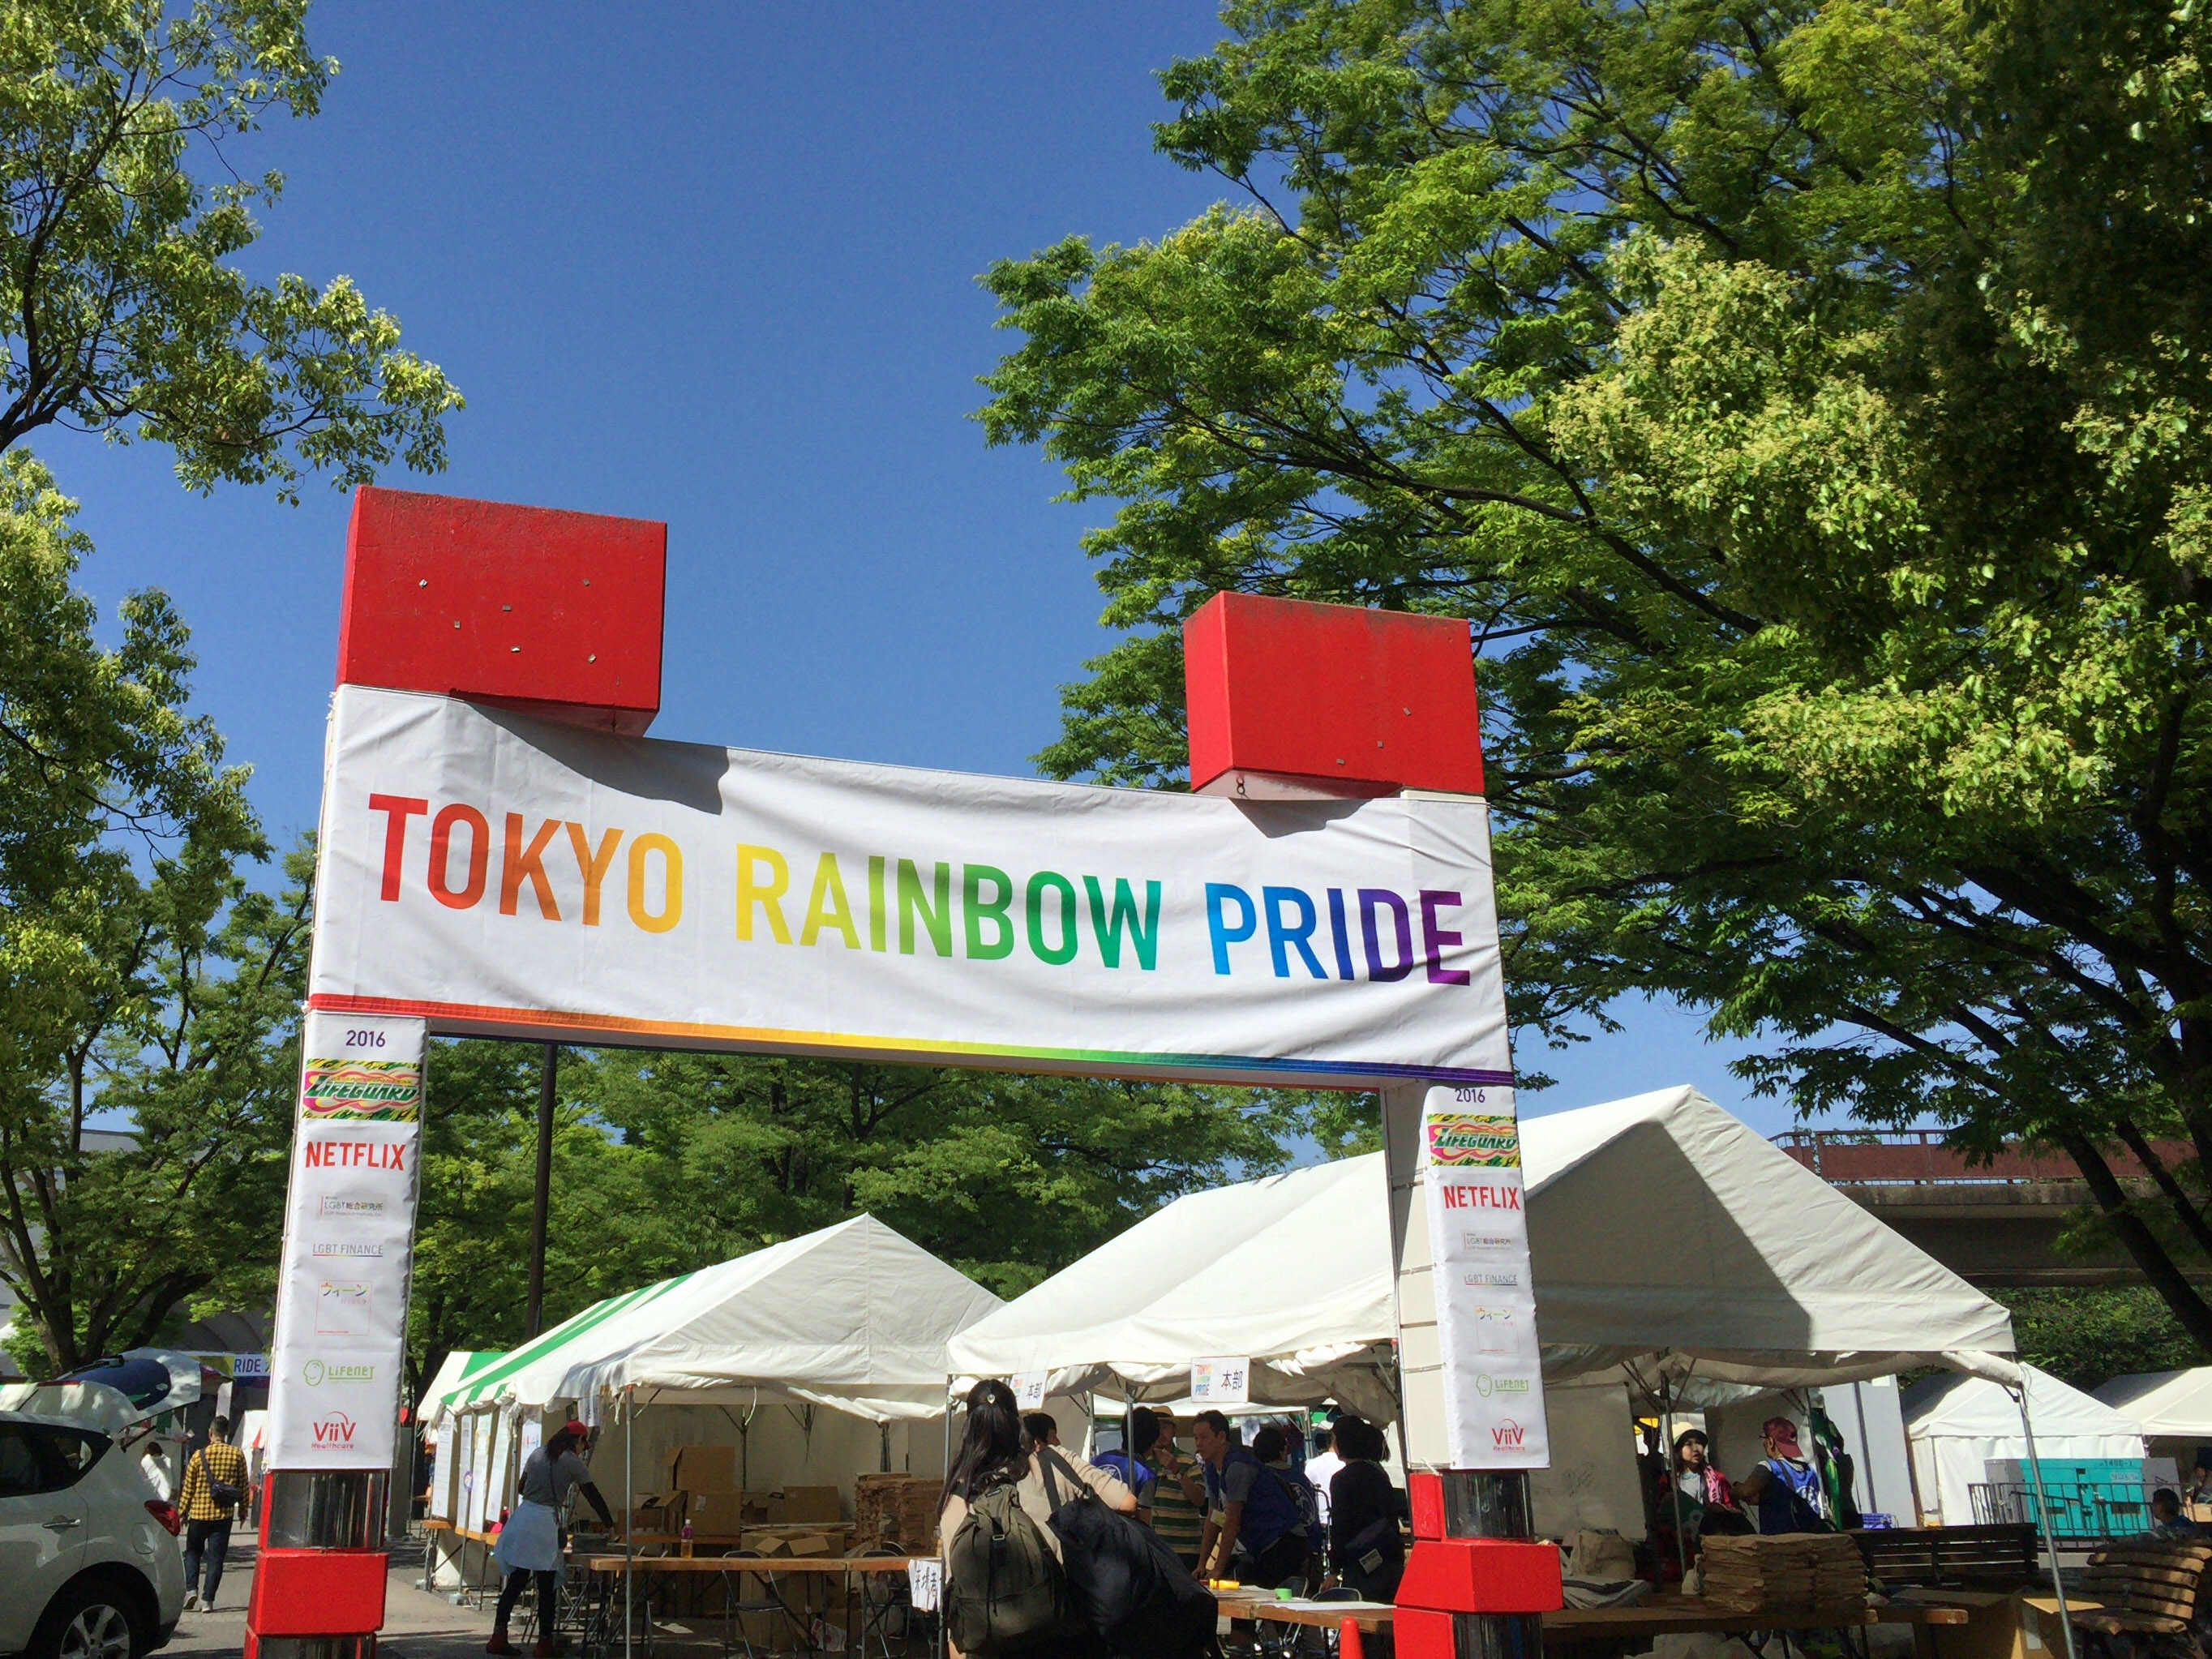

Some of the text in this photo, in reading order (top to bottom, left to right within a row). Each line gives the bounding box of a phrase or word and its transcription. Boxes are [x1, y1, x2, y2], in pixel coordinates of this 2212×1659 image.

[369, 793, 1470, 986] TOKYO RAINBOW PRIDE
[345, 1030, 386, 1048] 2016
[305, 1075, 418, 1101] LIFEGUARD
[1455, 1088, 1485, 1103] 2016
[1432, 1128, 1516, 1150] LIFEGUARD
[305, 1141, 406, 1171] NETFLIX
[1443, 1185, 1520, 1211] NETFLIX
[312, 1243, 384, 1255] LGBT FINANCE
[1464, 1274, 1518, 1284] LGBT FINANCE
[234, 1358, 261, 1373] RIDE
[1221, 1370, 1243, 1391] 本部
[313, 1421, 357, 1441] ViiV
[1492, 1428, 1524, 1444] ViiV
